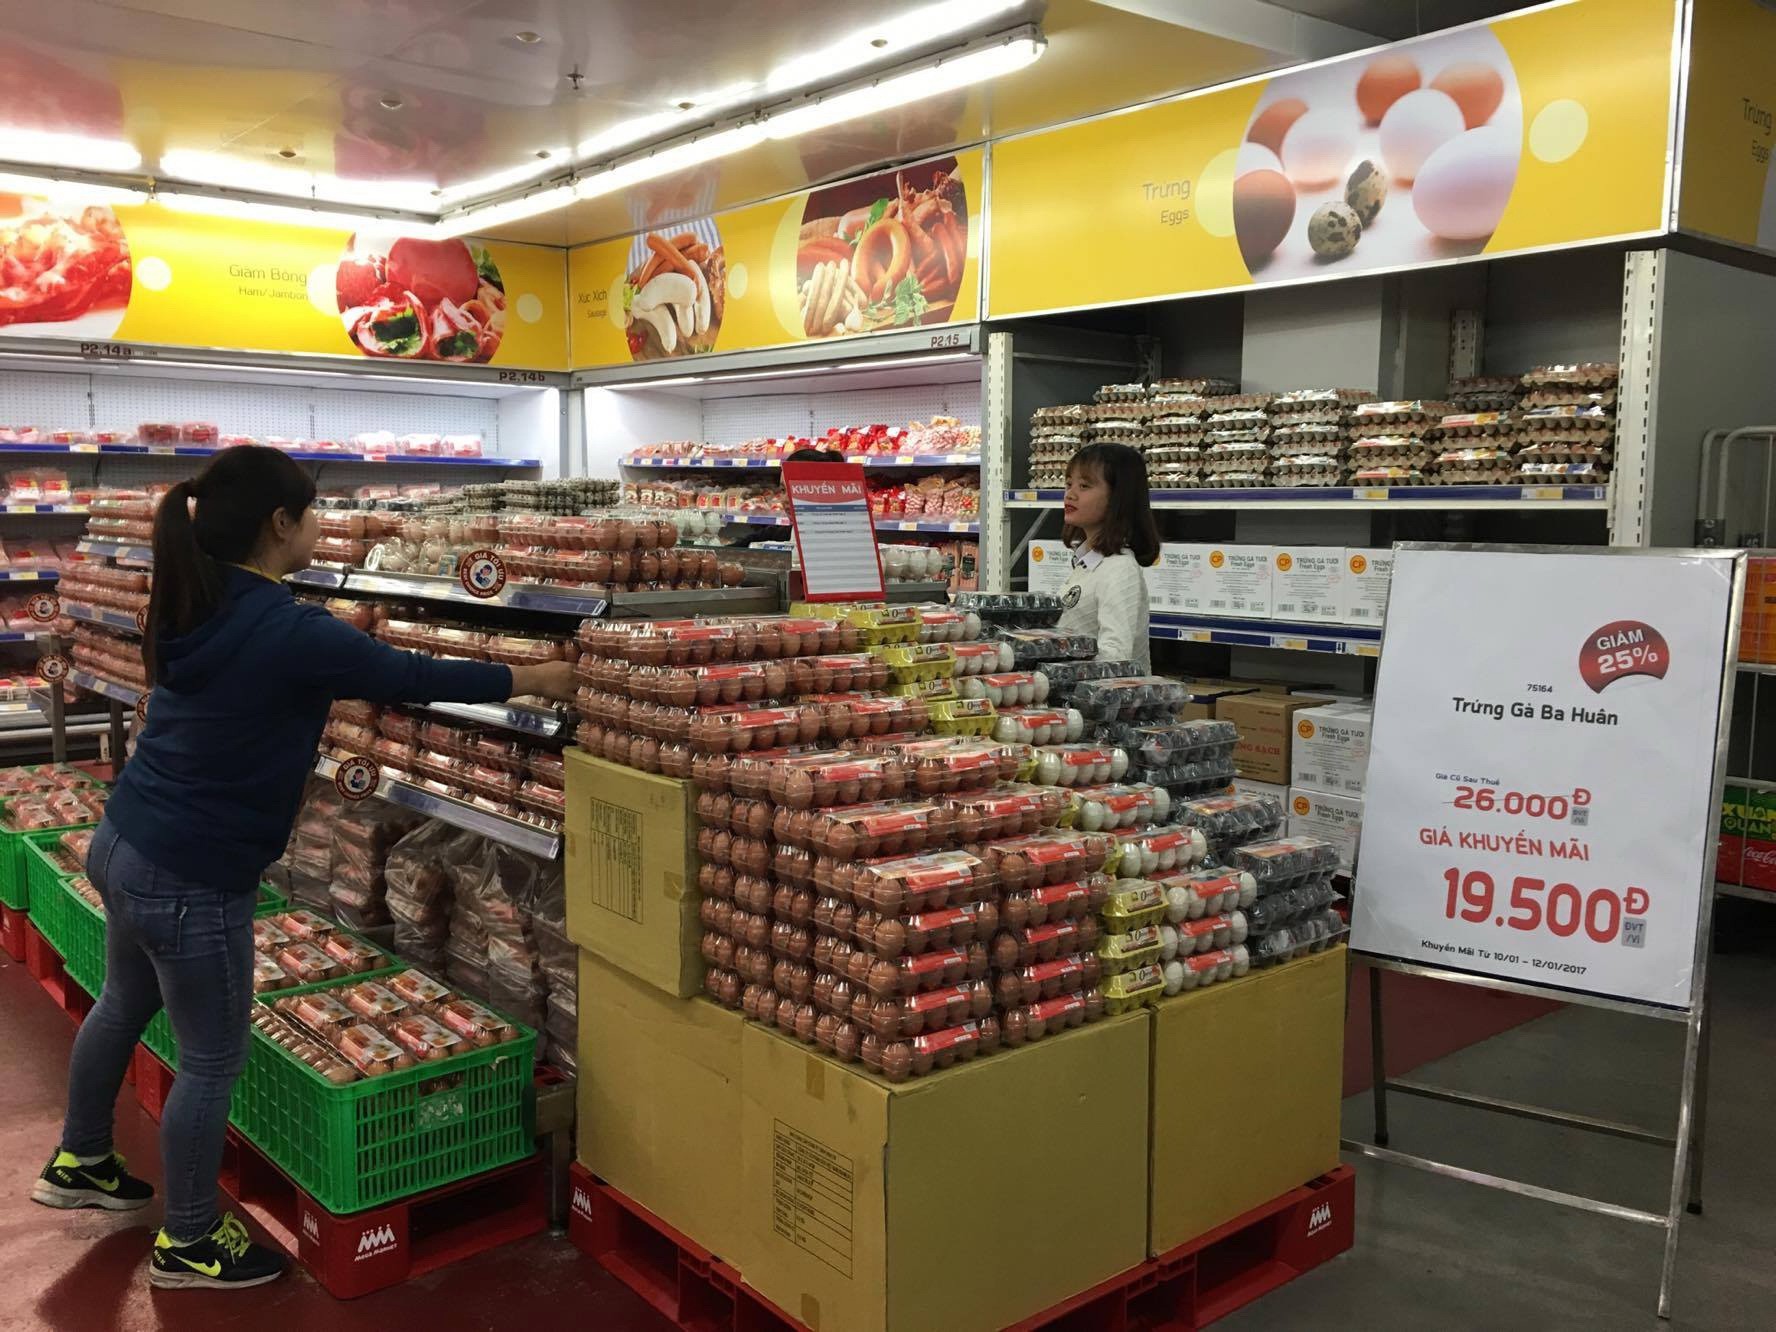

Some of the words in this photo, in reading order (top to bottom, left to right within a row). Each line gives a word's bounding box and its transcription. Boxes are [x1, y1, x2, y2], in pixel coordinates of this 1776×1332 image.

[1161, 209, 1189, 226] Eggs
[1597, 629, 1646, 651] GIẢM
[1597, 644, 1659, 674] 25%
[1527, 683, 1553, 693] 75164
[1452, 697, 1505, 721] Trứng
[1510, 702, 1535, 719] Gà
[1541, 704, 1565, 721] Ba
[1571, 706, 1619, 726] Huân
[1463, 775, 1479, 784] Sau
[1419, 825, 1453, 848] GIÁ
[1459, 829, 1543, 856] KHUYẾN
[1551, 838, 1590, 861] MÃI
[1421, 939, 1456, 953] Khuyến
[1458, 945, 1475, 957] Mãi
[1494, 952, 1520, 964] 10/01
[1531, 958, 1587, 975] 12/01/2017
